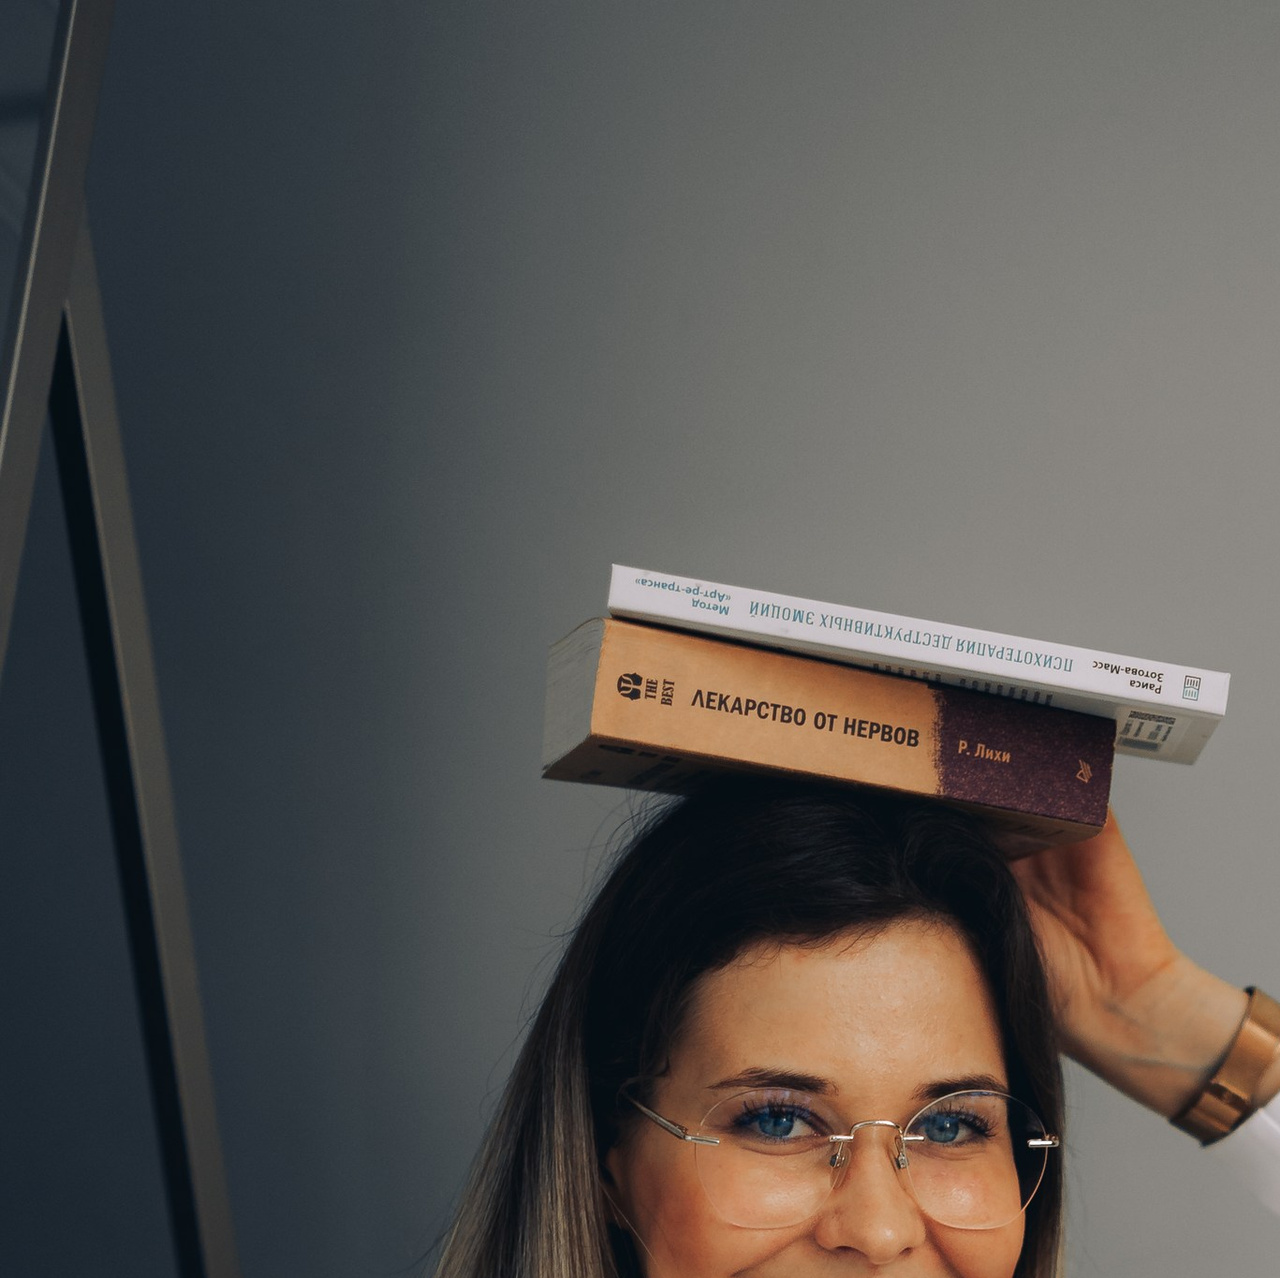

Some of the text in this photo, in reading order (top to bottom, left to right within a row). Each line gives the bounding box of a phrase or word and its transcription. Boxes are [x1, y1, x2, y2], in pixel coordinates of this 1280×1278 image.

[634, 578, 731, 603] «Арт-ре-транса»
[691, 598, 730, 616] Метод
[749, 600, 815, 625] ЭМОЦИЙ
[819, 613, 952, 650] ДЕСТРУКТИВНЫХ
[956, 638, 1073, 672] ПСИХОТЕРАПИЯ
[1092, 660, 1164, 682] Зотова-Масс
[644, 678, 658, 700] THE
[660, 679, 675, 706] BEST
[1129, 678, 1162, 695] Раиса
[691, 689, 919, 747] ЛЕКАРСТВО ОТ НЕРВОВ
[958, 740, 1011, 763] Р. Лихи
